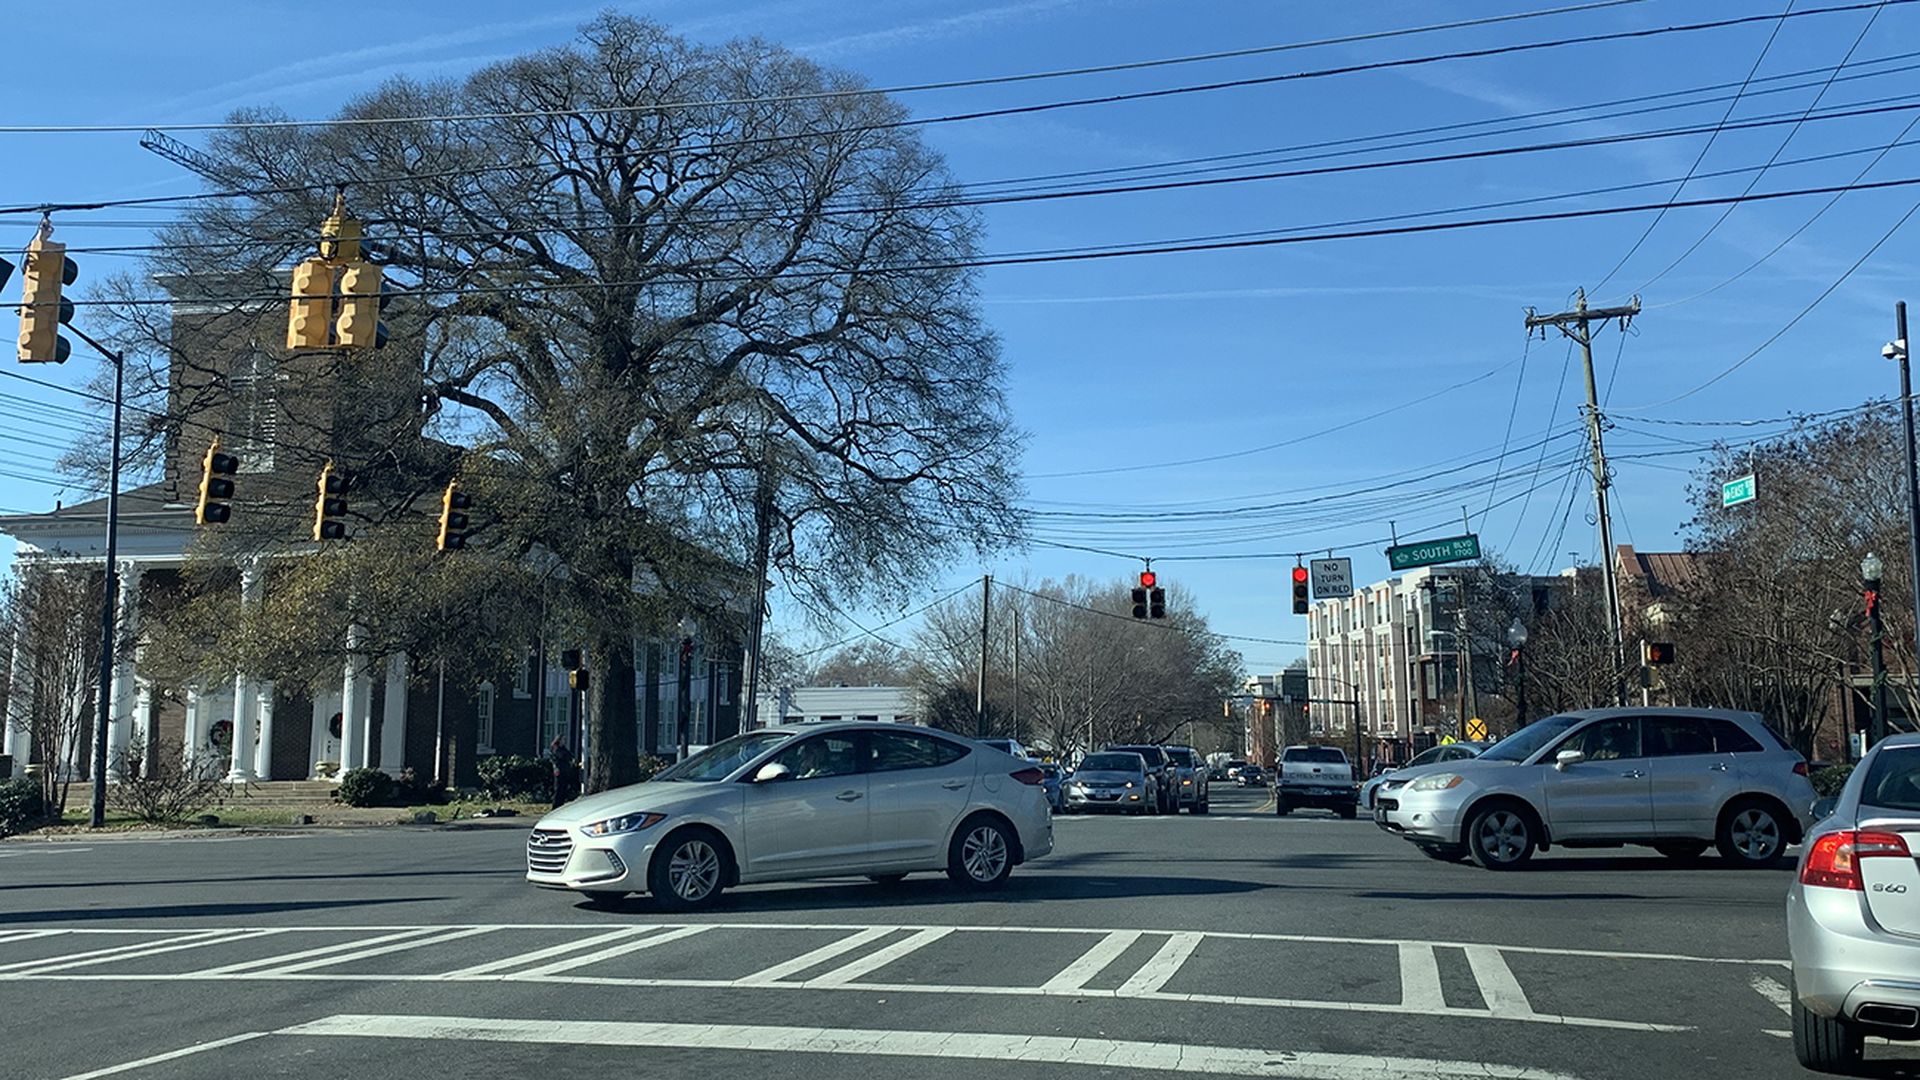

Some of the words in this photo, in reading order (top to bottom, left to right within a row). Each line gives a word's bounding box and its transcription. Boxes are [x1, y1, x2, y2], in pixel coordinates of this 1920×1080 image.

[1412, 546, 1451, 561] SOUTH
[1453, 540, 1473, 549] BLVD
[1455, 548, 1473, 557] 1700
[1324, 563, 1339, 571] NO
[1321, 574, 1345, 582] TURN
[1317, 586, 1330, 594] ON
[1332, 585, 1350, 593] RED
[1873, 883, 1907, 894] S60
